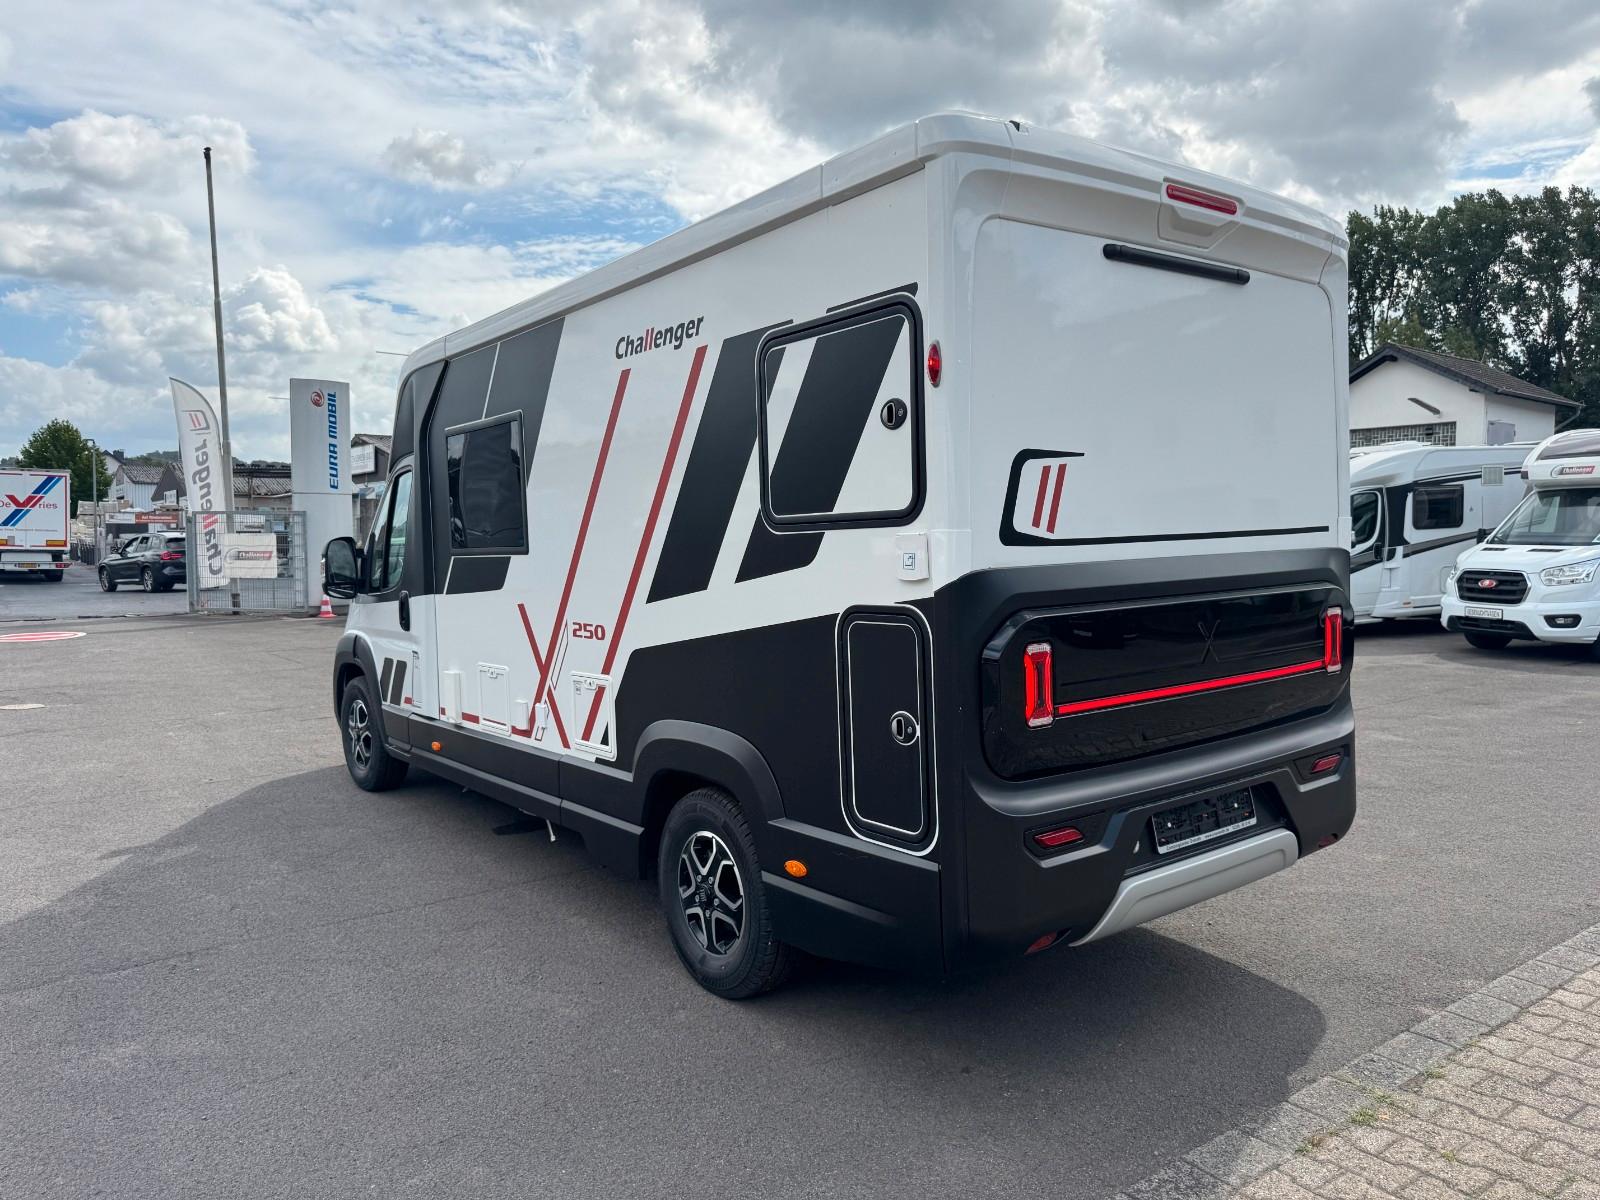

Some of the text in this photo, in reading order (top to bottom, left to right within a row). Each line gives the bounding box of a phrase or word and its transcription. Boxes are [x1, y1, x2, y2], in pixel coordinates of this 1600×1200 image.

[616, 316, 704, 360] Challenger
[328, 391, 339, 490] EURA MOBIL
[572, 621, 606, 641] 250
